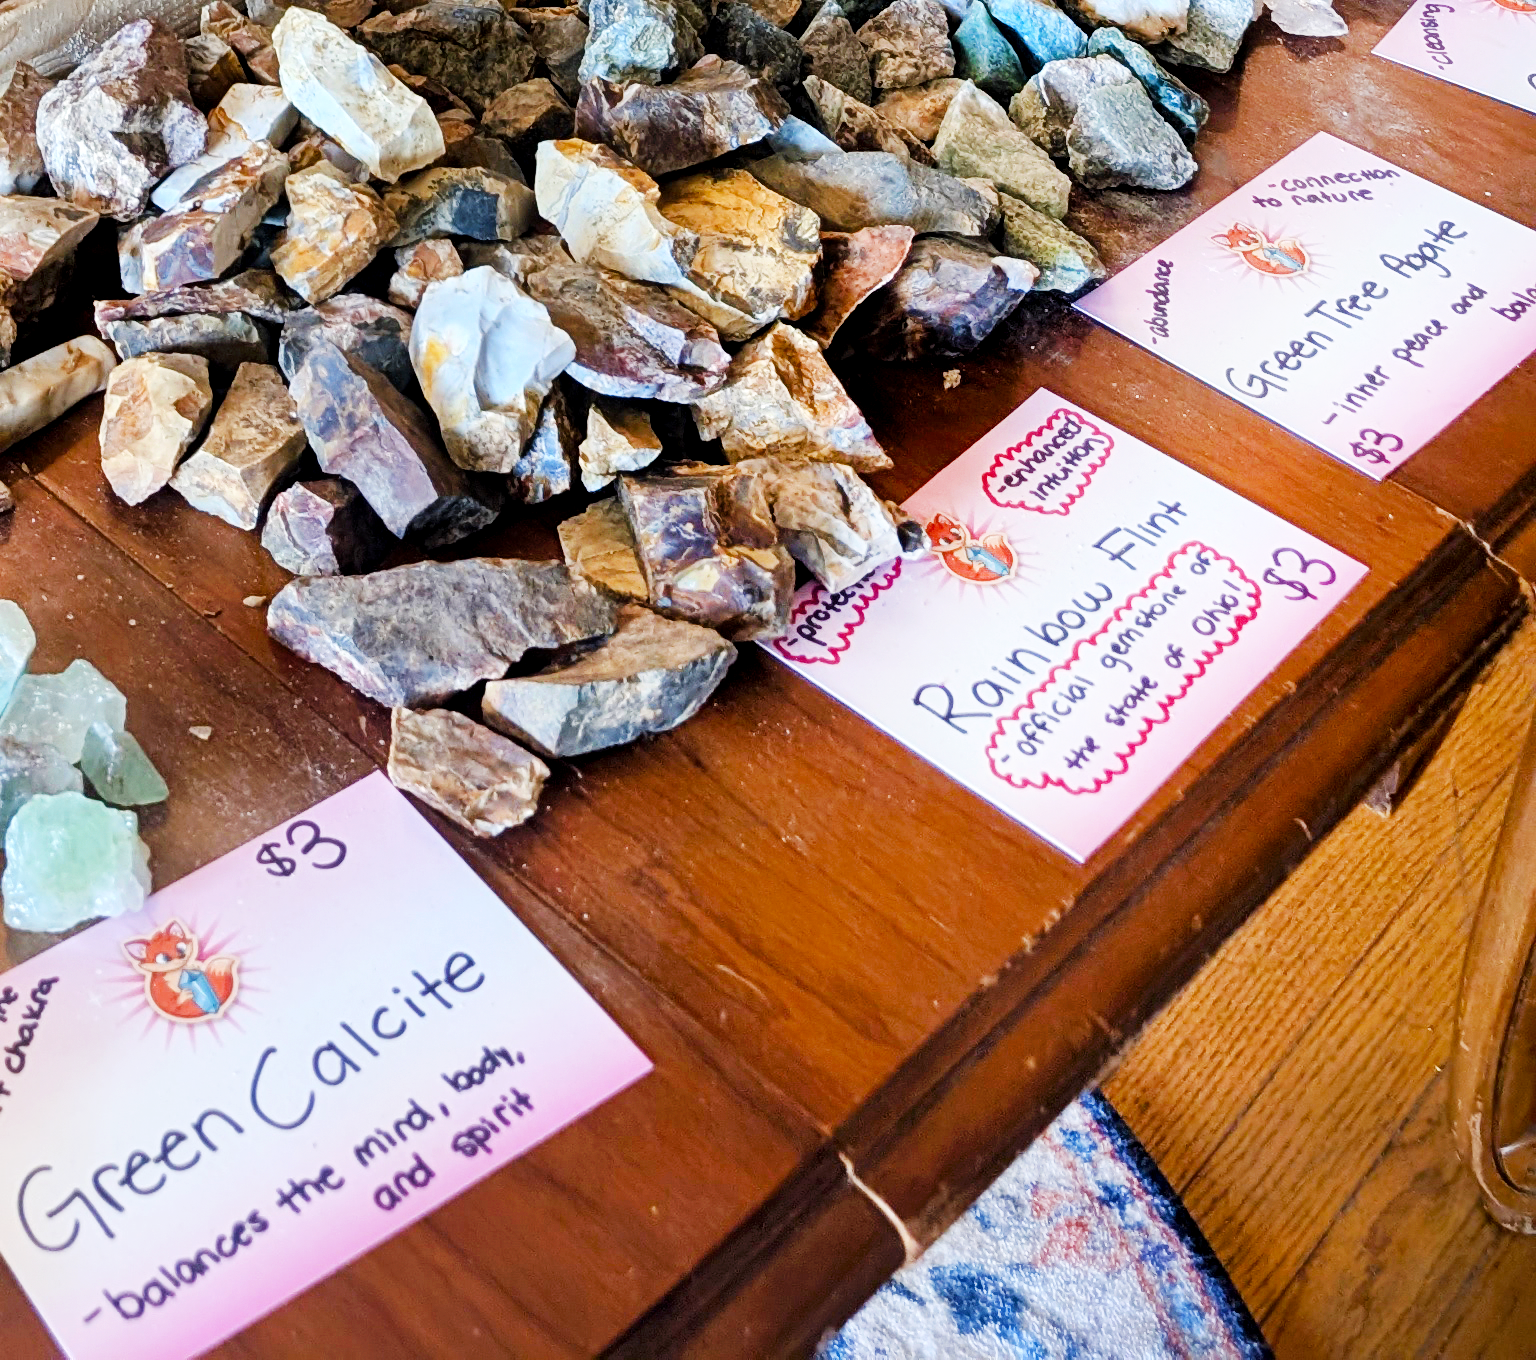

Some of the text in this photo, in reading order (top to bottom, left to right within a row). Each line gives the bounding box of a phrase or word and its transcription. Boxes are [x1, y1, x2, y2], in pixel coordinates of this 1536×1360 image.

[1252, 186, 1374, 209] to nature
[1226, 218, 1468, 401] Green Tree Agate
[1391, 318, 1449, 370] peace
[1451, 282, 1488, 315] and
[1348, 427, 1405, 465] $3
[912, 499, 1188, 734] Rainbow Flint
[1100, 580, 1187, 671] gemstone
[1190, 548, 1212, 577] of
[1263, 547, 1338, 602] $3
[1064, 736, 1101, 771] the
[1105, 675, 1159, 728] state
[1164, 644, 1186, 669] of
[255, 818, 347, 879] $3
[5, 975, 59, 1077] chakra
[17, 949, 486, 1252] Green Calcite
[276, 1162, 347, 1218] the
[354, 1097, 451, 1168] mind,
[371, 1090, 537, 1213] and spirit
